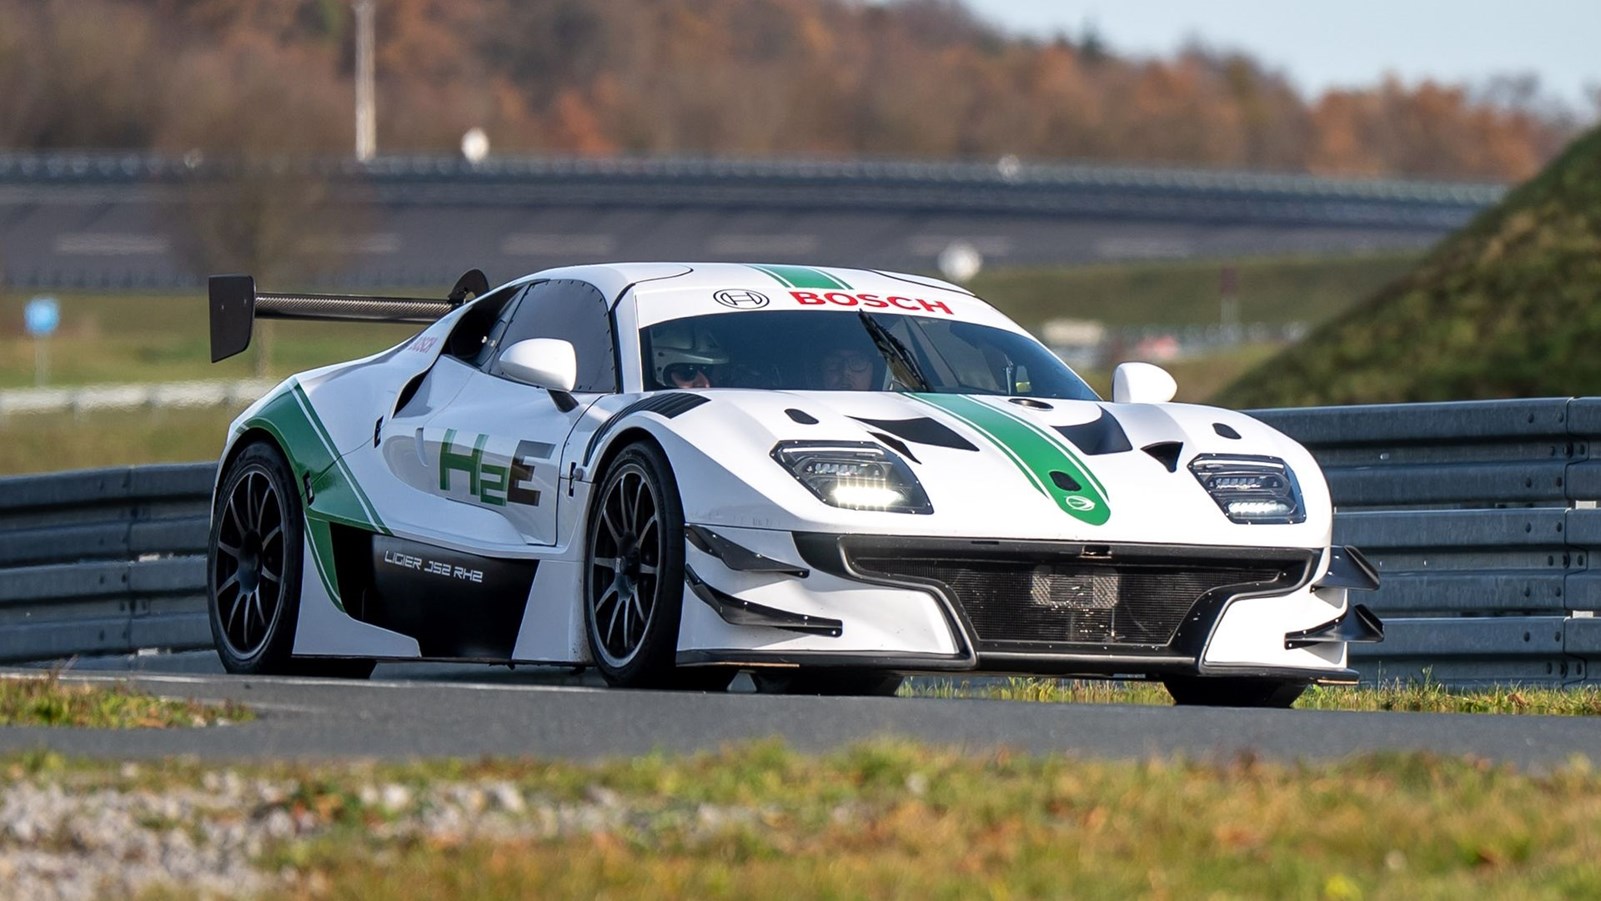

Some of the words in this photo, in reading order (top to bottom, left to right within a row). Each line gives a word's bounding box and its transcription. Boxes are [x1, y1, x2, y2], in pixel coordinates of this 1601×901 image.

[789, 291, 954, 315] BOSCH
[439, 428, 556, 507] H2E
[384, 550, 422, 570] LIGIER
[424, 560, 452, 576] JS2
[453, 566, 483, 583] RH2
